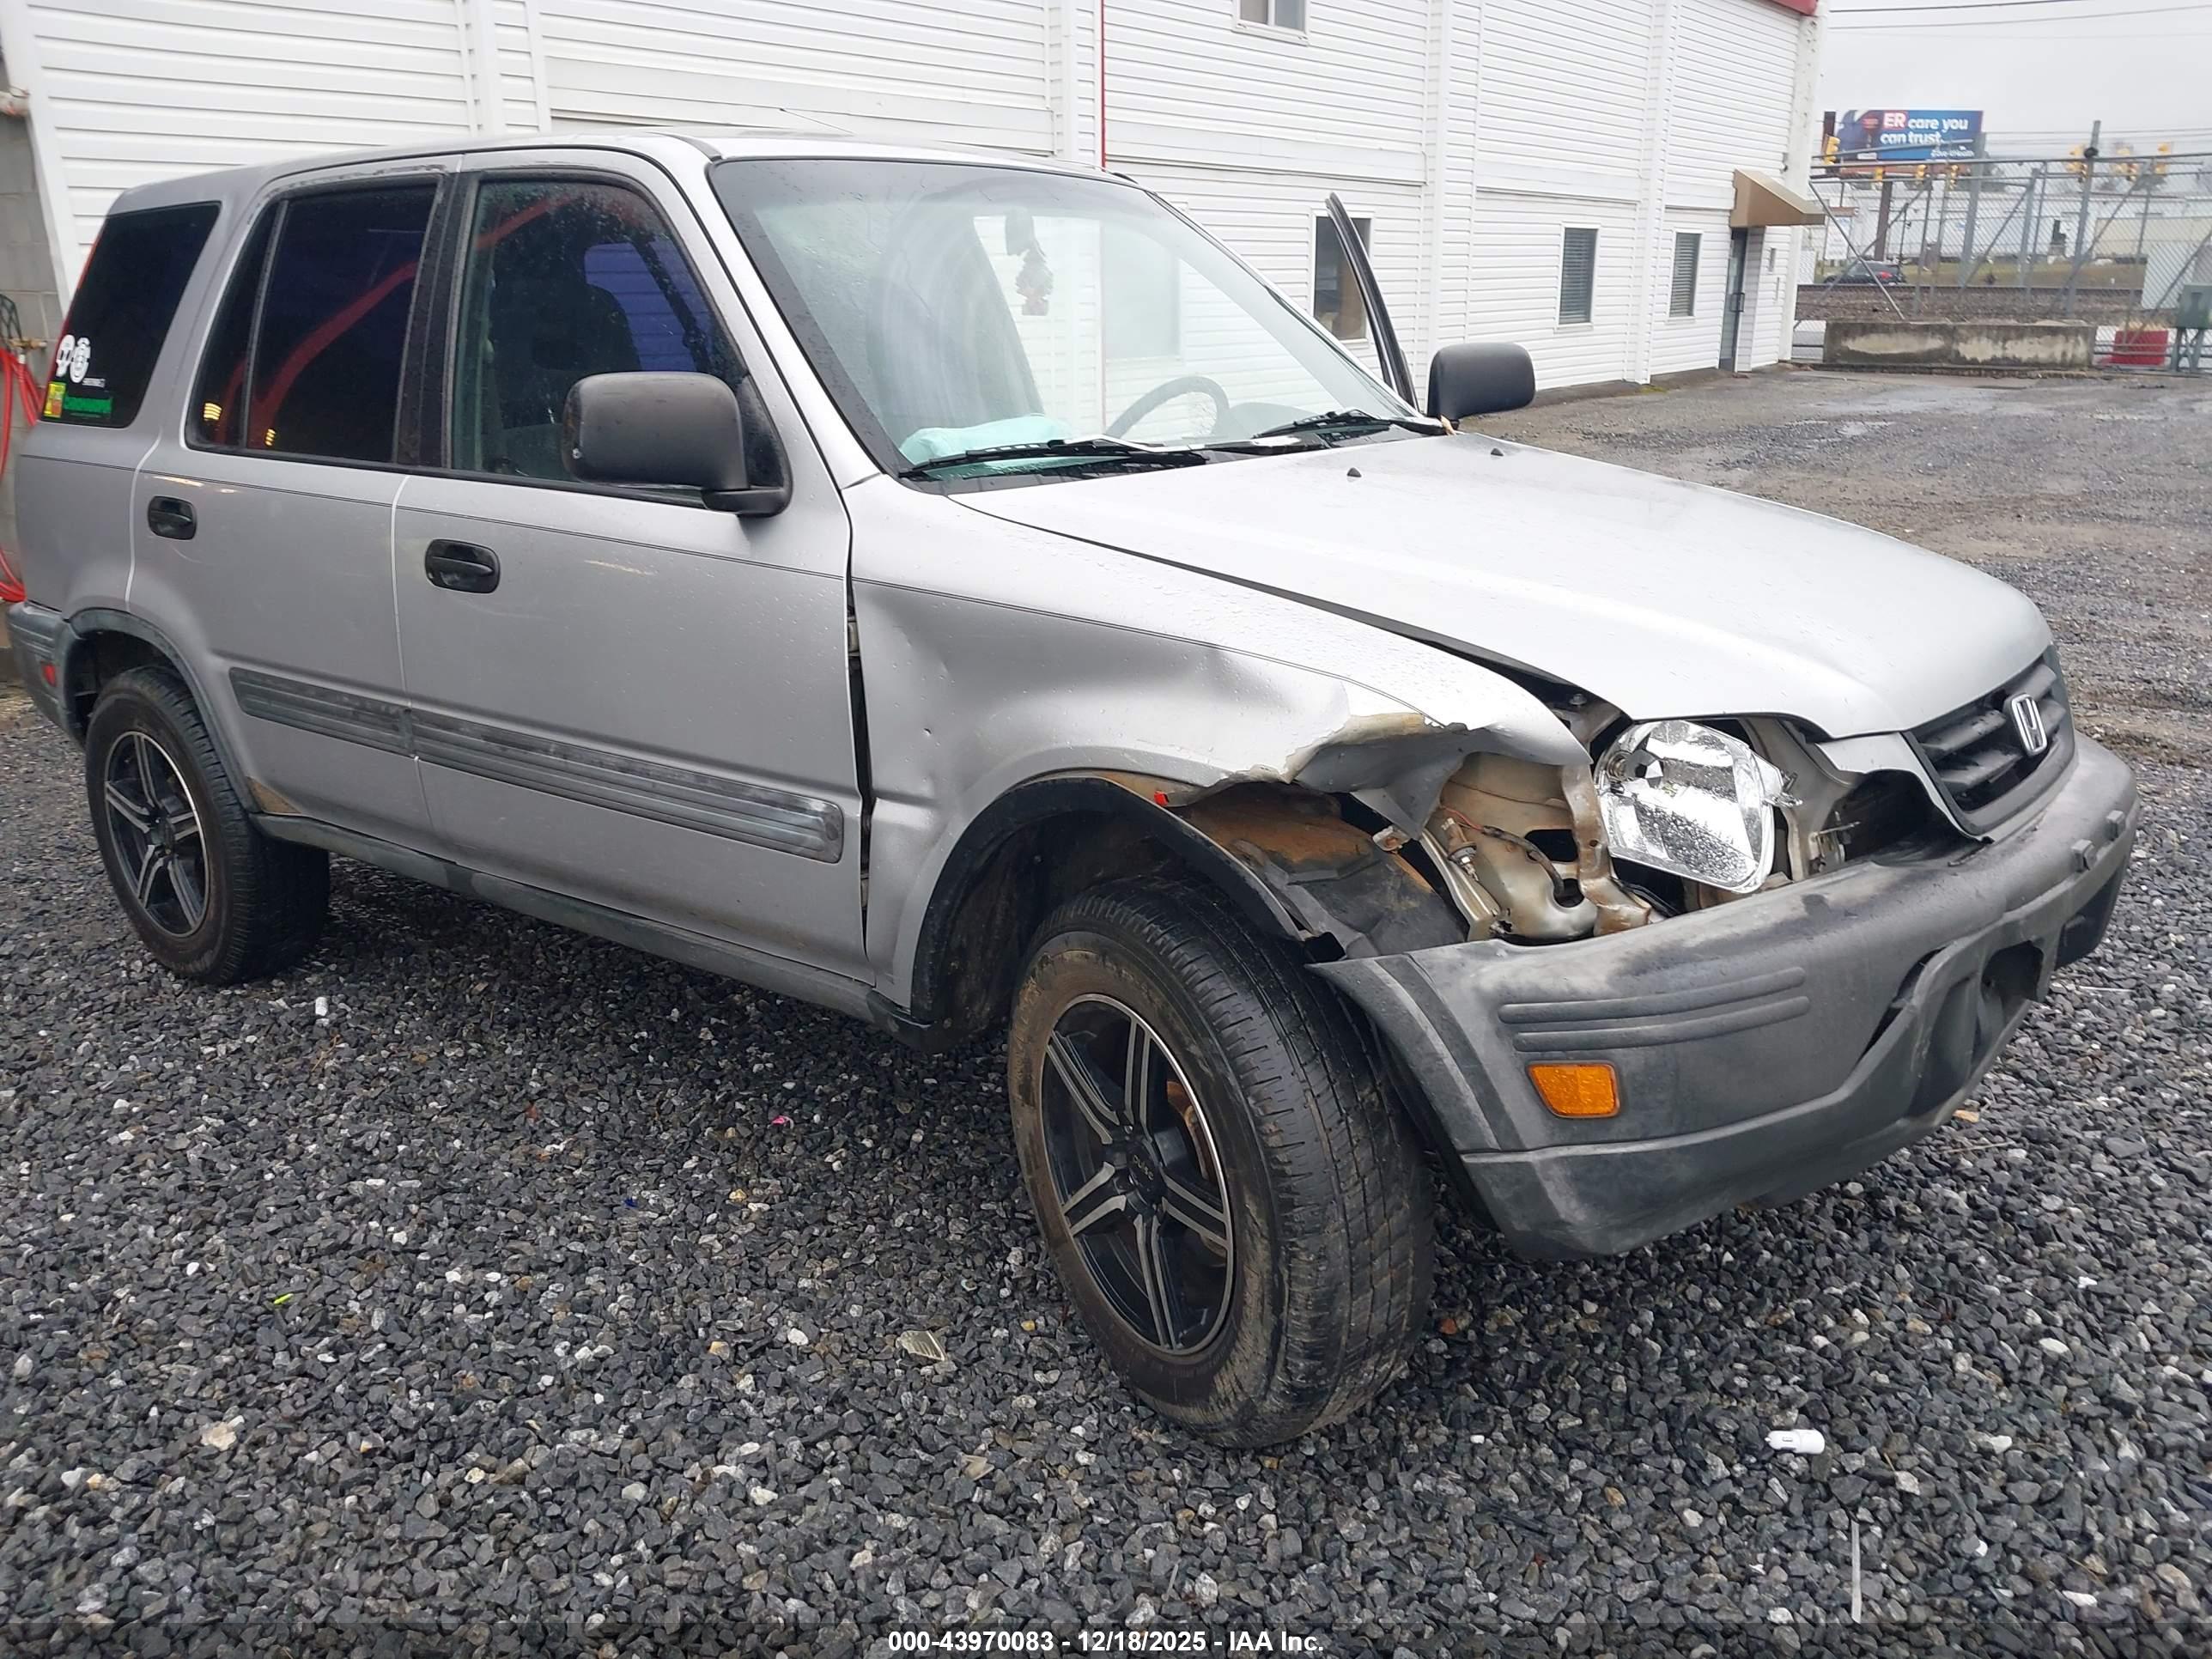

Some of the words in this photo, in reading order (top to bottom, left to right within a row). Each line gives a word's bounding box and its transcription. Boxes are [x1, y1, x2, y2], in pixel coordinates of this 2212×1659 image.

[1883, 112, 1906, 129] ER
[1908, 118, 1939, 130] care
[1942, 118, 1969, 133] you
[1880, 133, 1906, 144] can
